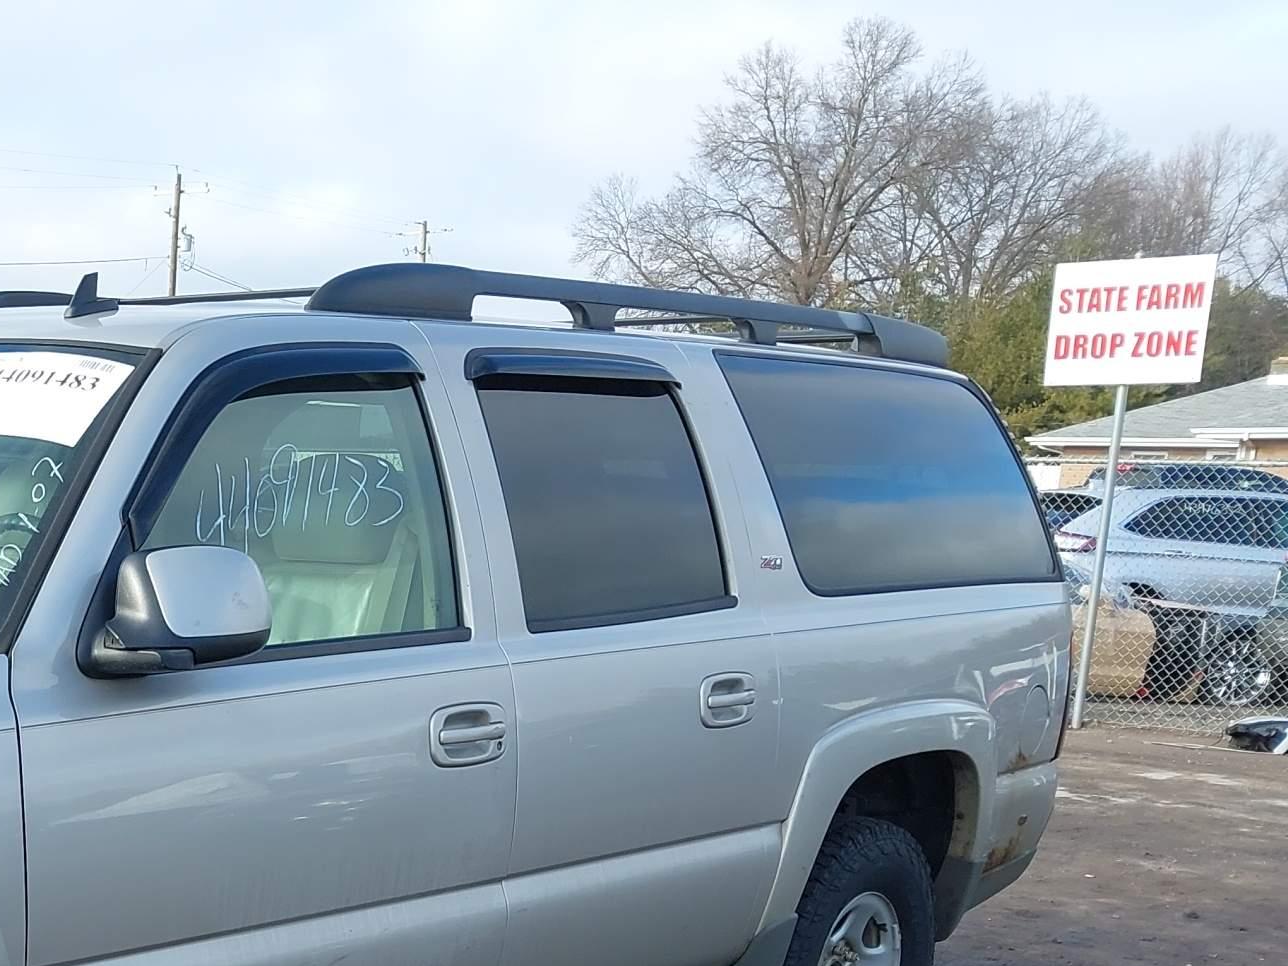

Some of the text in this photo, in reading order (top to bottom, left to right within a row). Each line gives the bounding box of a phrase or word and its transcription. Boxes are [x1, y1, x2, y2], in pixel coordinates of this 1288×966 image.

[1058, 281, 1206, 314] STATE FARM
[1054, 329, 1199, 360] DROP ZONE
